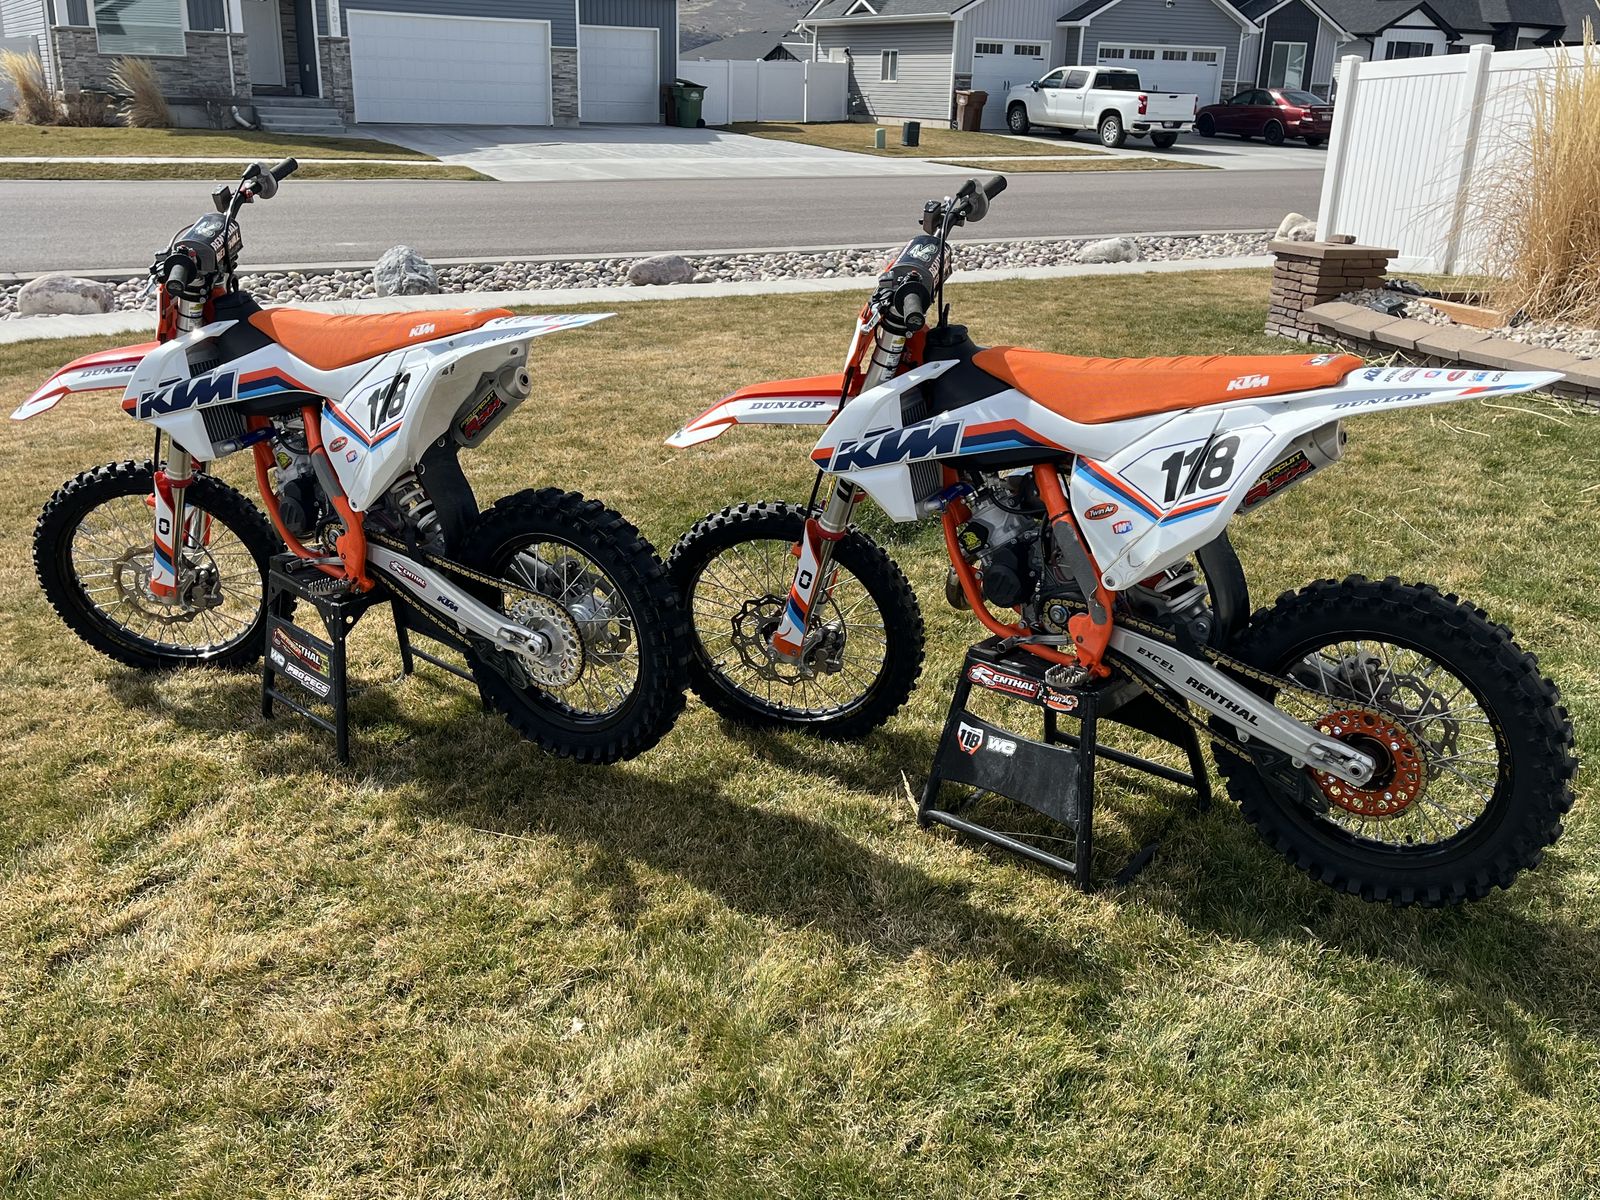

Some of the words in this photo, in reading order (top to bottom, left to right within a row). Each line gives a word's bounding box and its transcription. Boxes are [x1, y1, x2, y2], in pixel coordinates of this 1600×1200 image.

[409, 323, 435, 337] KTM
[80, 365, 137, 378] DUNLO
[1226, 374, 1270, 391] KTM
[140, 369, 236, 419] KTM
[368, 372, 411, 432] 118
[1333, 391, 1432, 410] DUNLOP
[749, 401, 826, 410] DUNLOP
[832, 419, 962, 472] KTM
[1161, 435, 1241, 503] 118
[437, 596, 459, 612] KTM
[1137, 647, 1176, 672] EXCEL
[287, 664, 304, 680] PRO
[304, 674, 330, 693] PEGS
[1186, 677, 1259, 726] RENTHAL
[960, 728, 980, 748] 118
